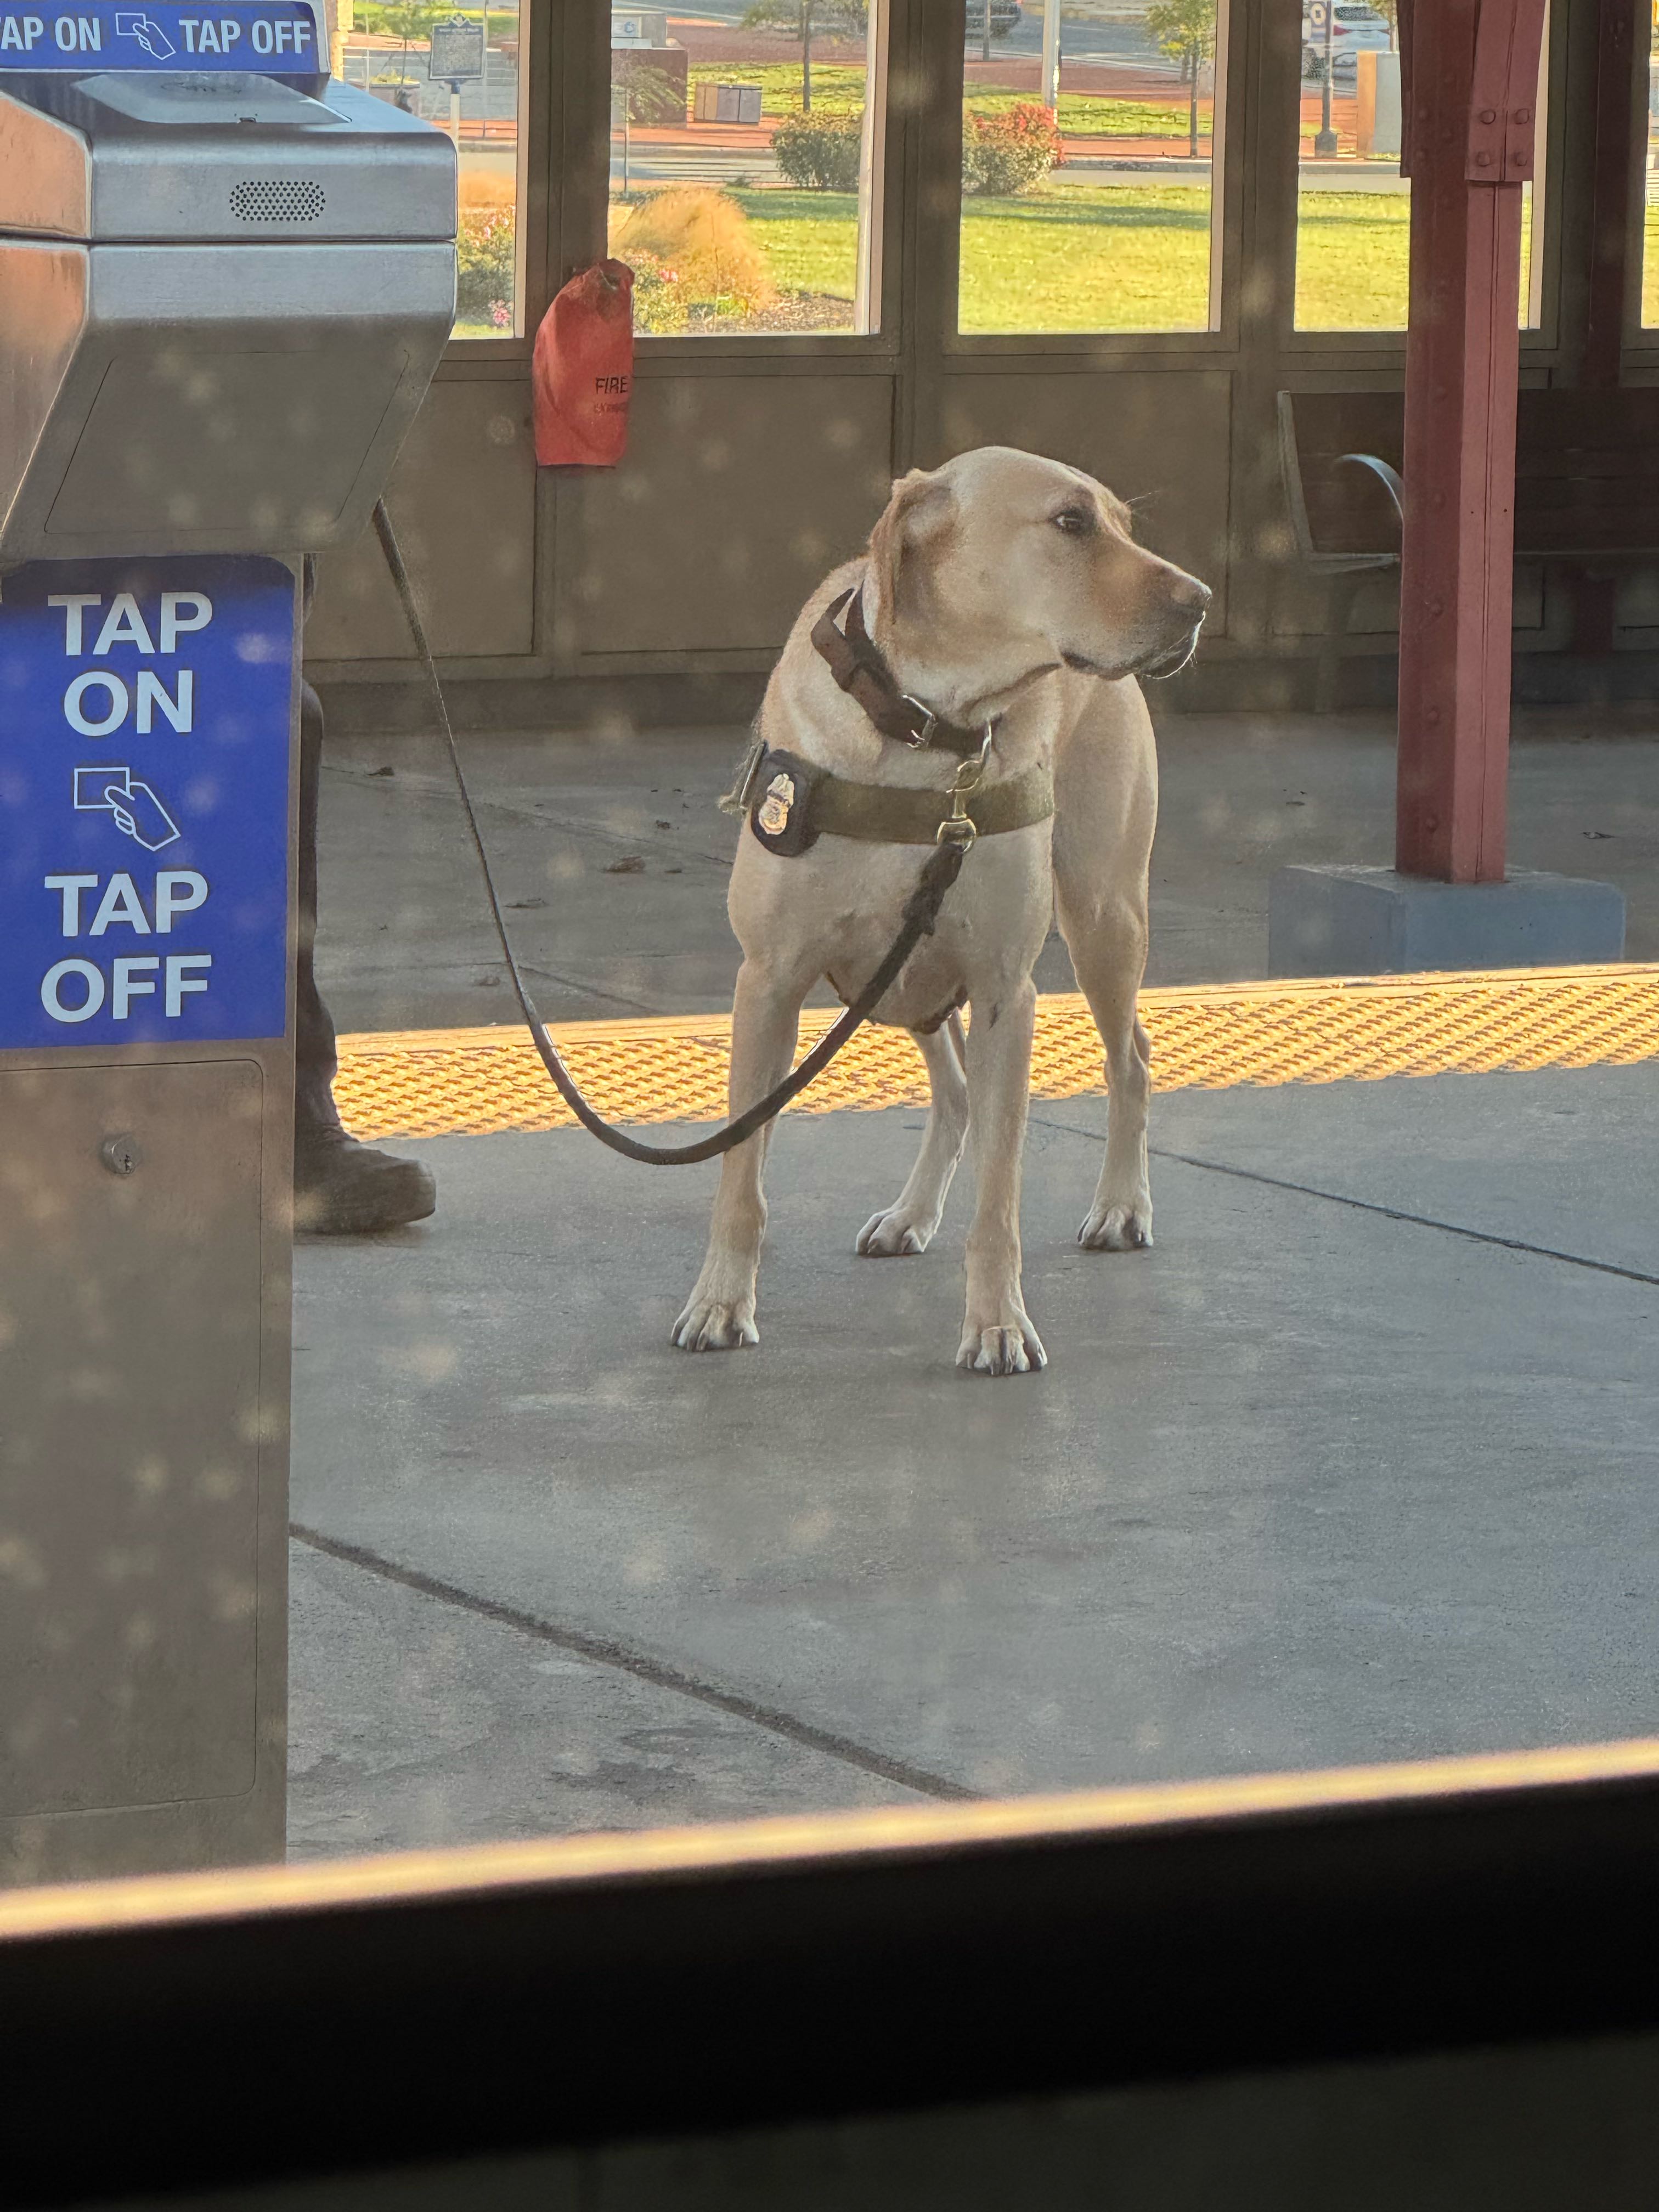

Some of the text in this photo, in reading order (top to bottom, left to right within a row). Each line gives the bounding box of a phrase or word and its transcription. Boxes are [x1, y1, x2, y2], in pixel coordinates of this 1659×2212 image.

[0, 17, 310, 53] AP ON TAP OFF
[596, 376, 628, 394] FIRE
[48, 592, 212, 656] TAP
[64, 670, 192, 736] ON
[45, 871, 208, 936] TAP
[41, 955, 212, 1022] OFF
